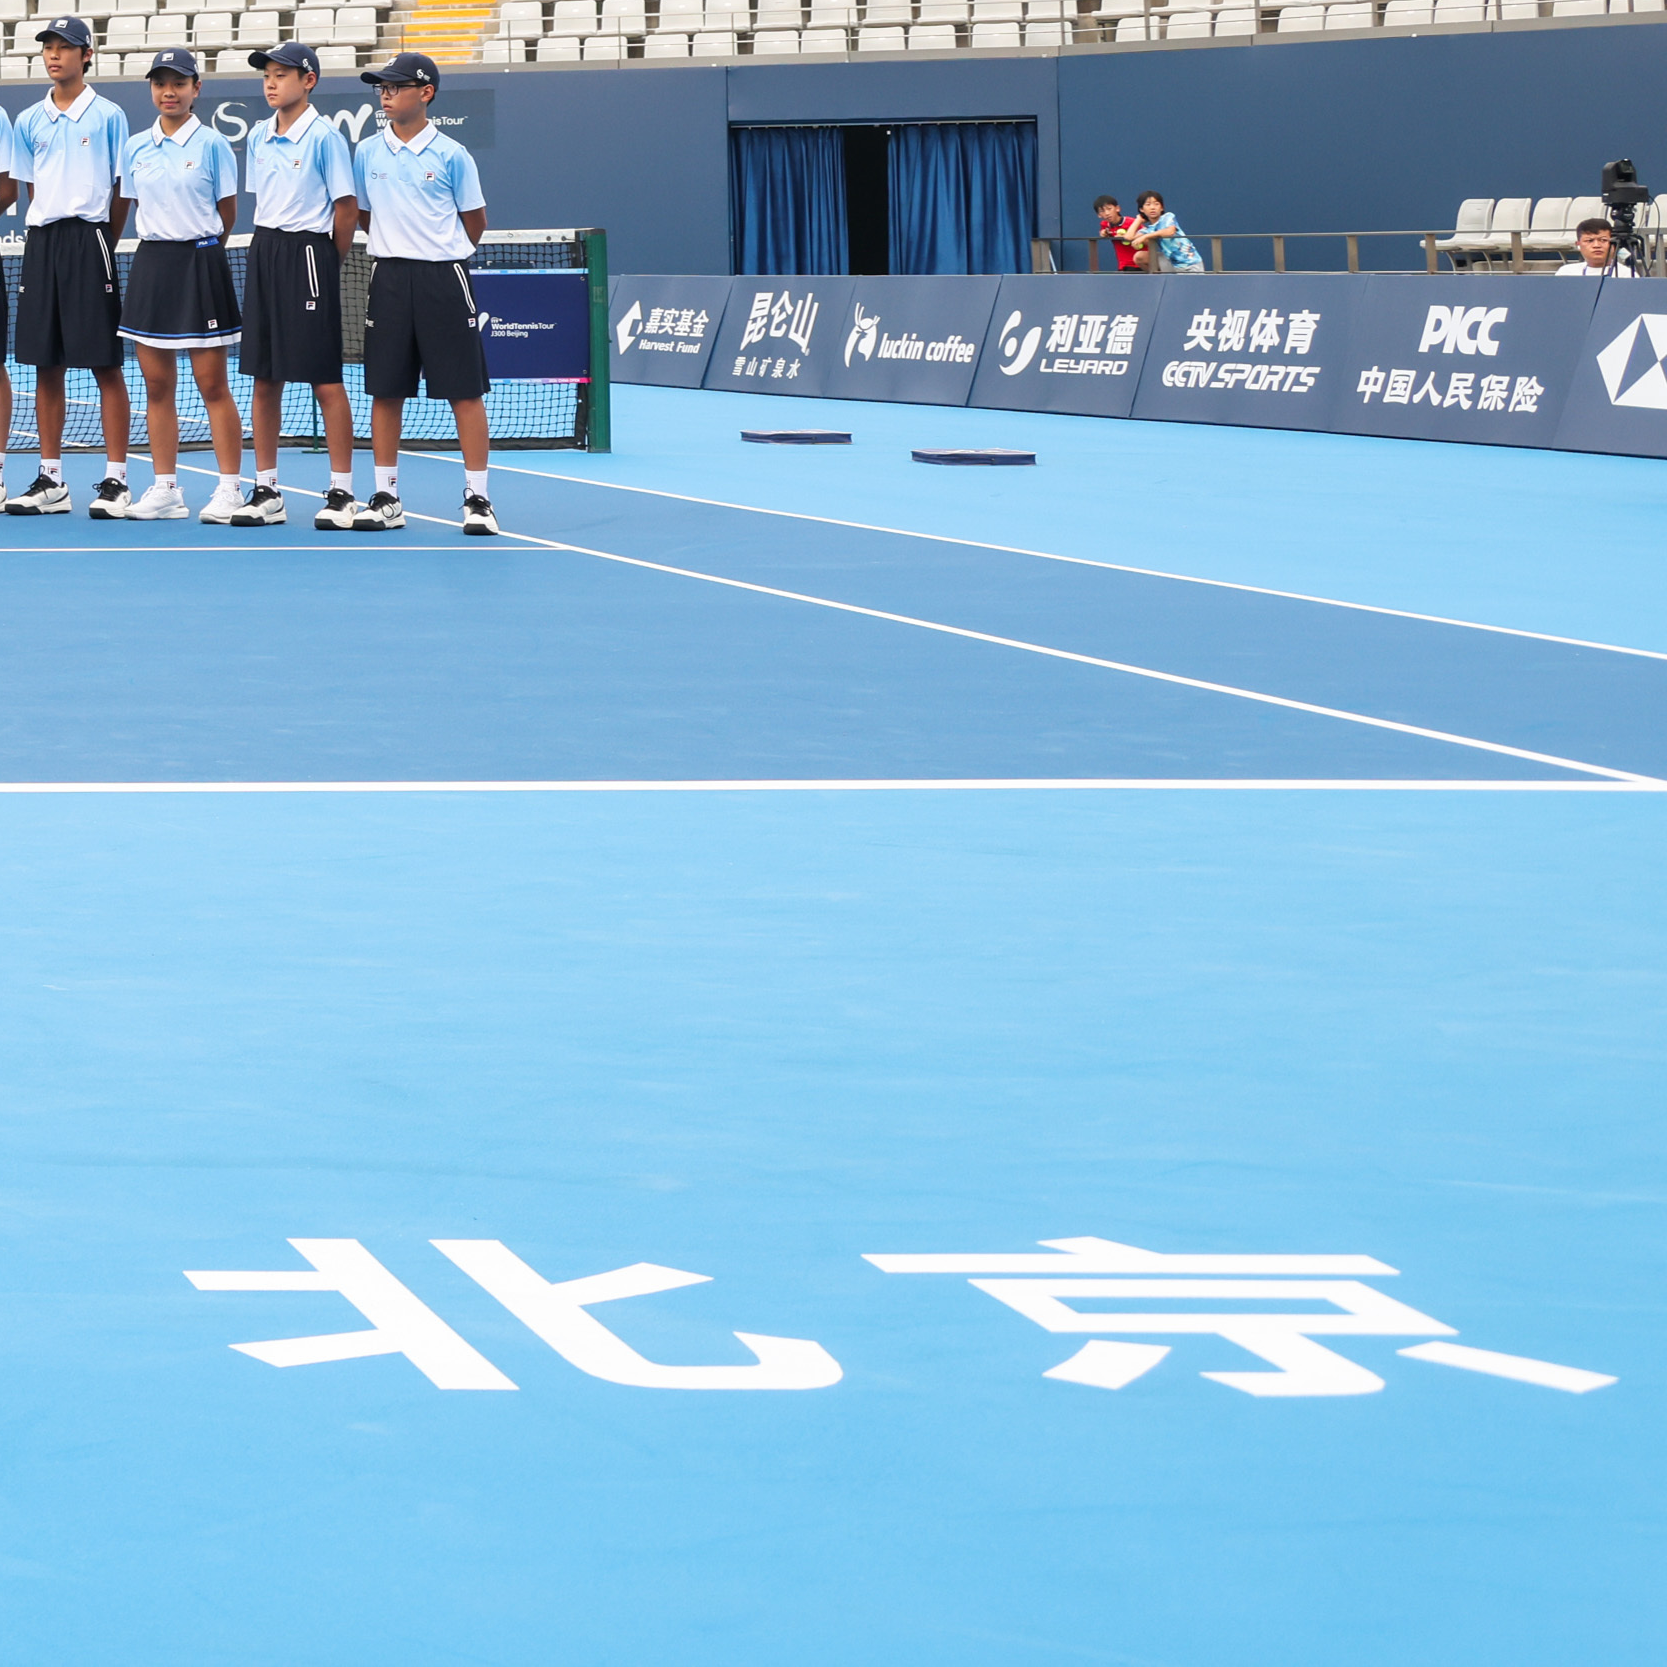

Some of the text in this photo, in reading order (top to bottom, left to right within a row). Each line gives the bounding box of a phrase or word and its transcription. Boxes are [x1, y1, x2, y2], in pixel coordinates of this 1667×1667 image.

[506, 330, 529, 338] Beijing
[645, 307, 710, 338] 嘉实基金
[740, 290, 819, 355] 昆仑山
[1045, 313, 1139, 356] 利亚德
[1183, 308, 1321, 355] 央视体育
[1417, 305, 1509, 356] PICC
[638, 338, 702, 355] Harvest Fund
[877, 332, 976, 365] luckin coffee
[732, 356, 801, 380] 雪山矿泉水
[1039, 358, 1129, 375] LEYARD
[1162, 360, 1321, 393] CCTV SPORTS
[1356, 365, 1545, 413] 中国人民保险
[182, 1235, 1617, 1397] 北京
